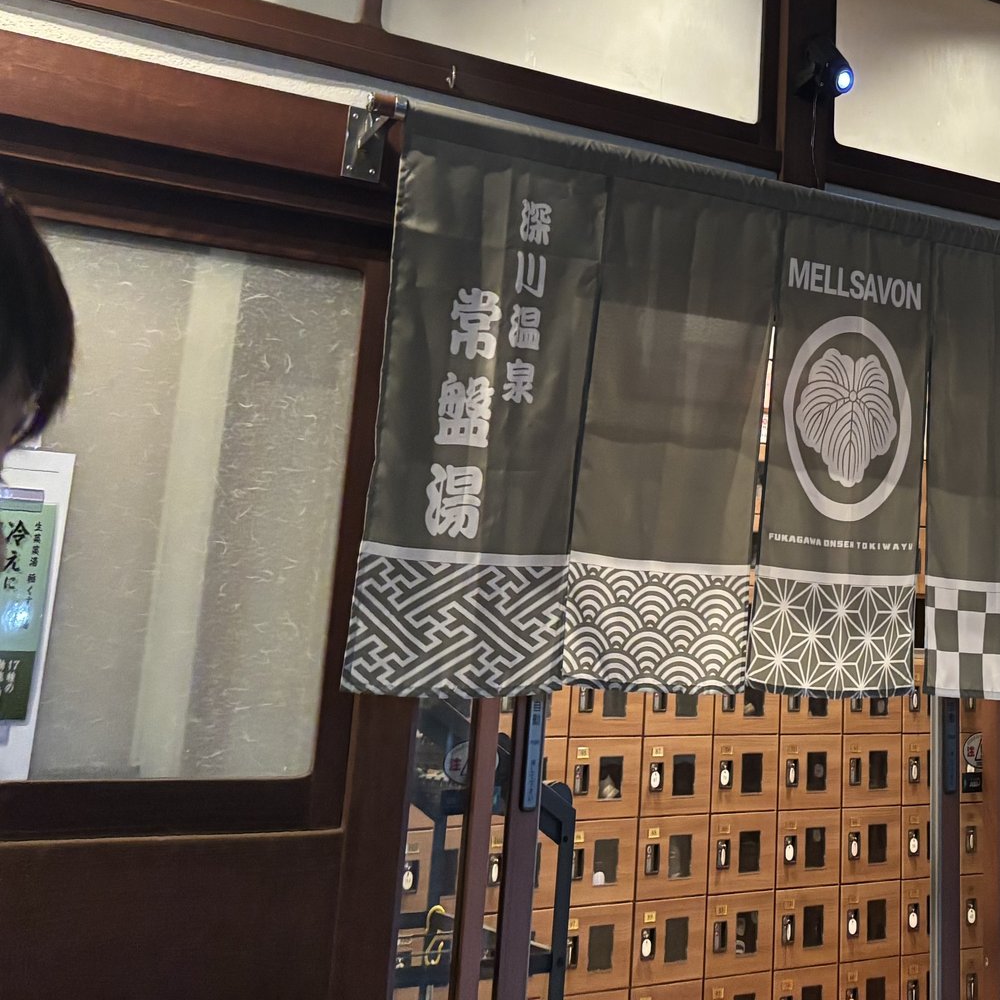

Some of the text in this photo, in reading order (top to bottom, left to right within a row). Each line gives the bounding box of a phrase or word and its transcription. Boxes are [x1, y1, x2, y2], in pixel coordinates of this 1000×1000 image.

[501, 198, 553, 405] 深川温泉
[788, 257, 921, 310] MELLSAVON
[424, 287, 503, 540] 常盤湯
[768, 532, 913, 551] FUKAGAWA ONSEN TOKIWAYU
